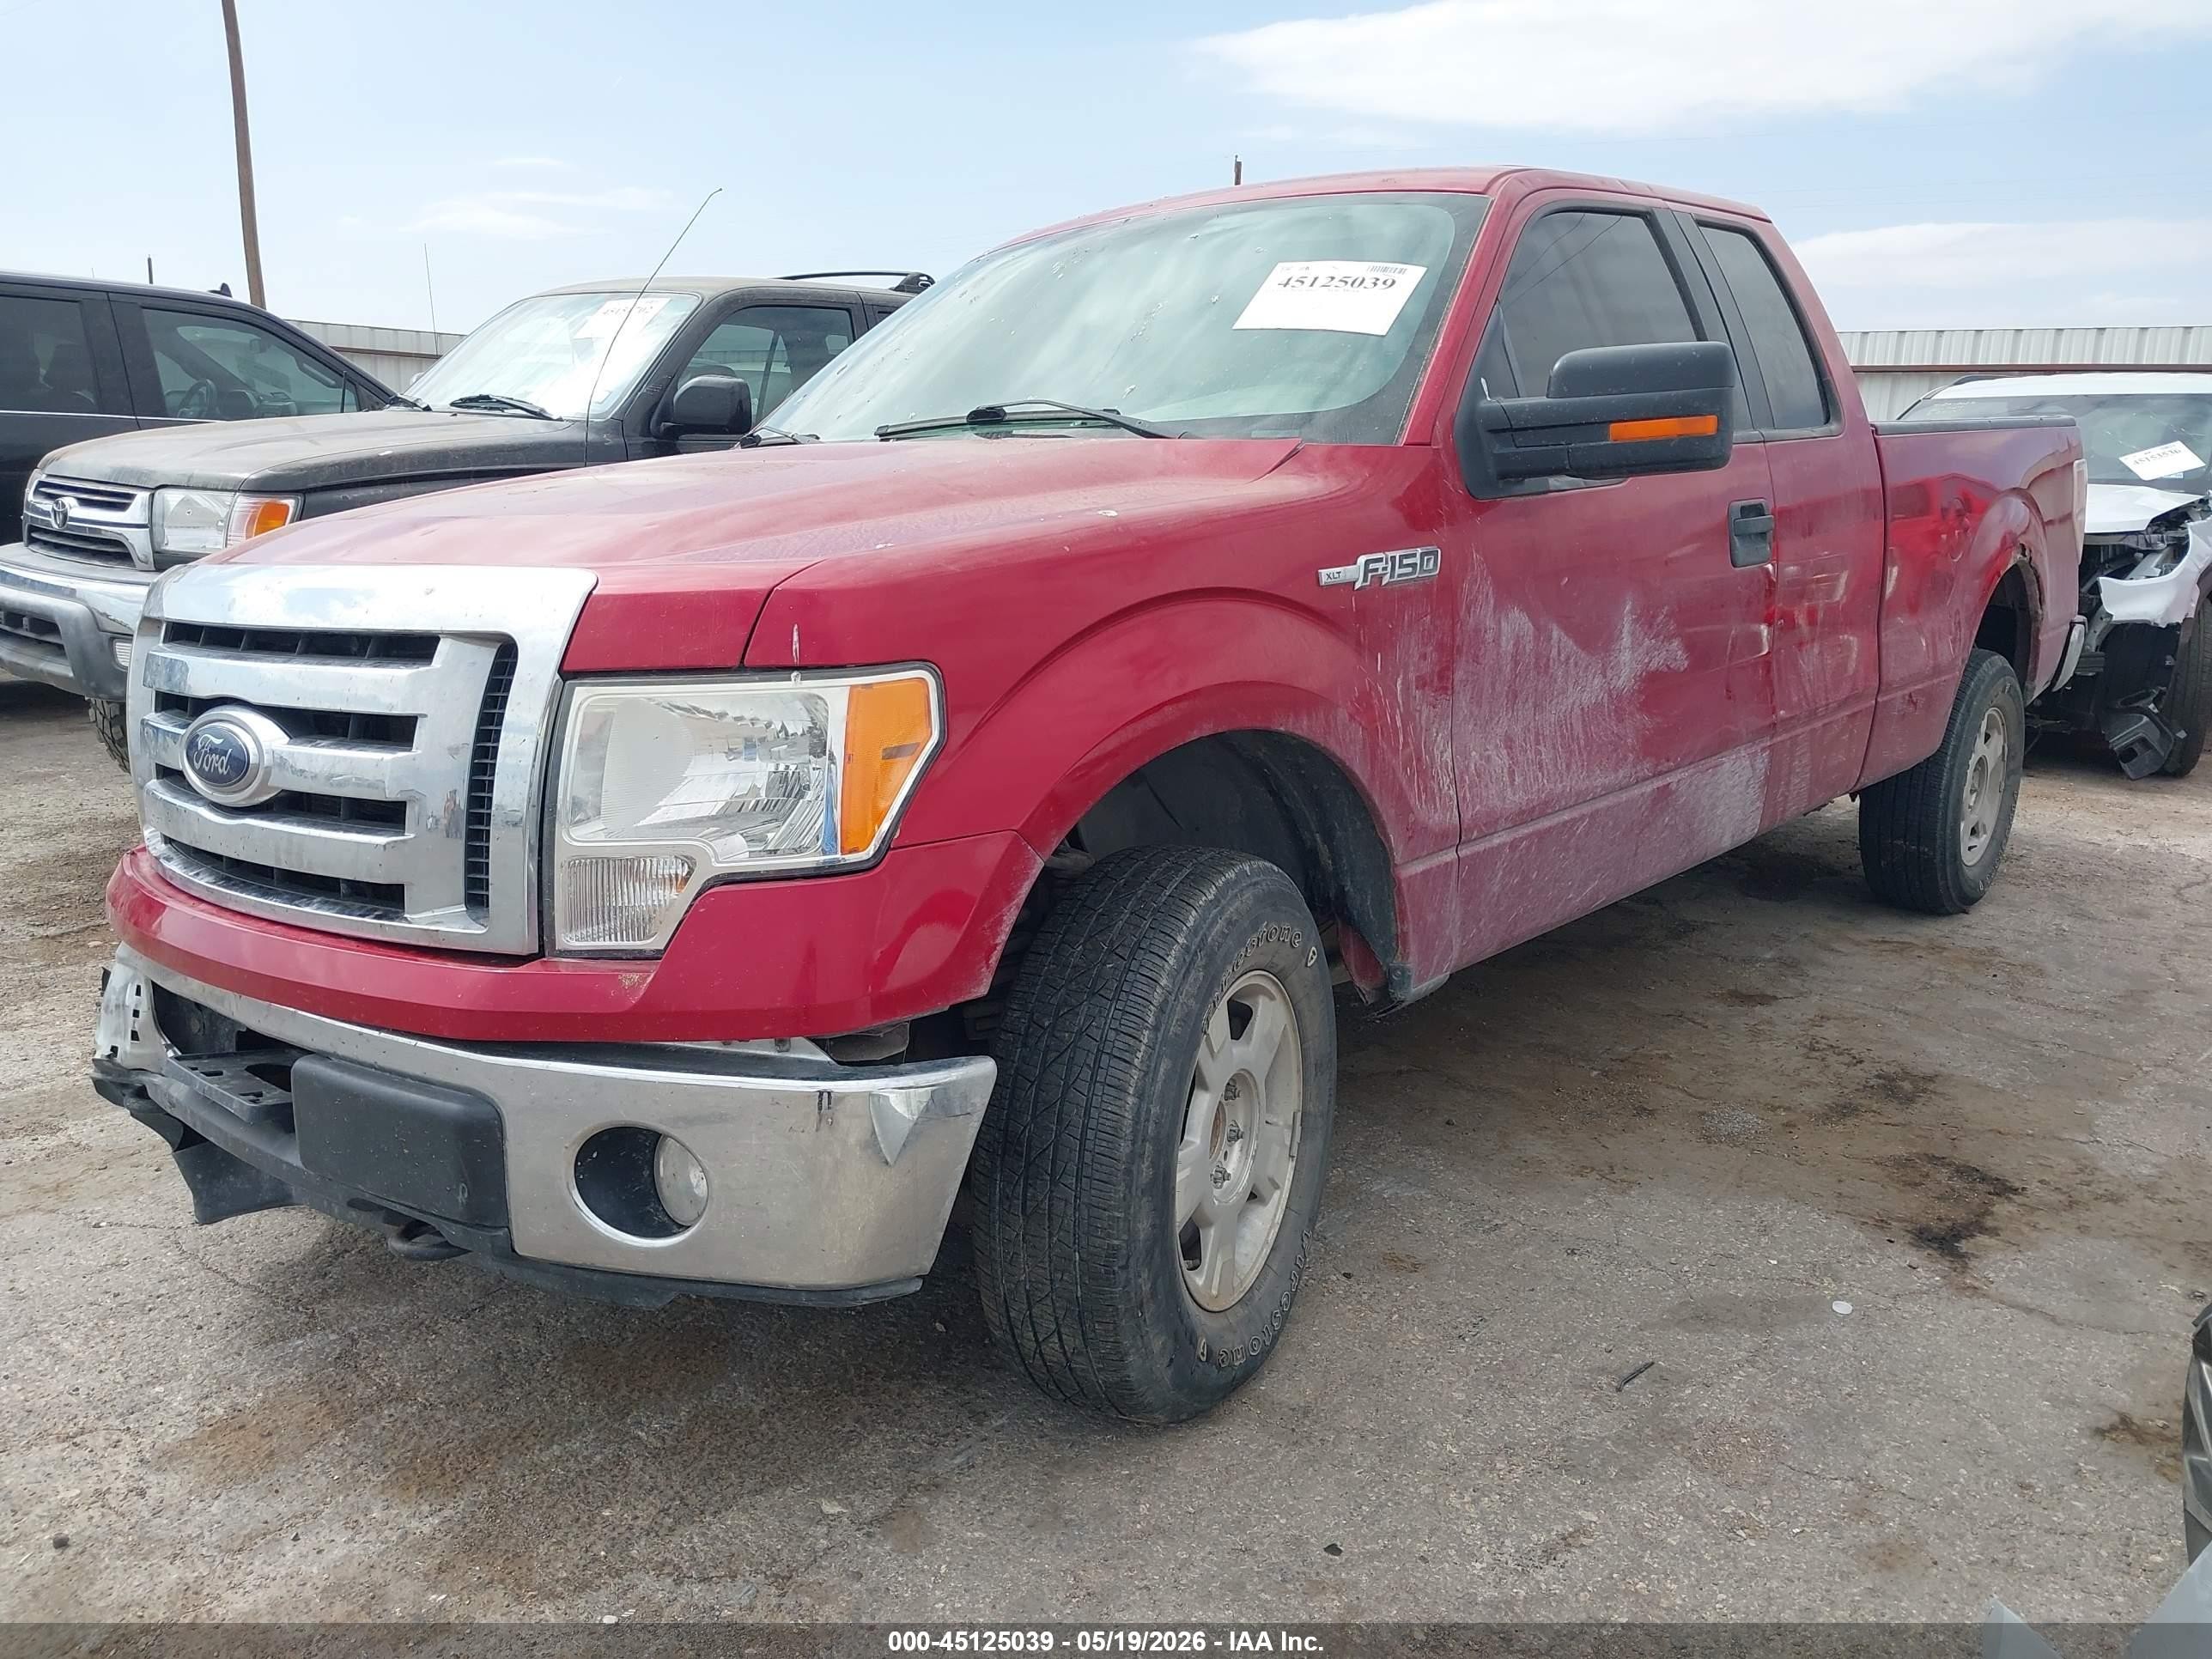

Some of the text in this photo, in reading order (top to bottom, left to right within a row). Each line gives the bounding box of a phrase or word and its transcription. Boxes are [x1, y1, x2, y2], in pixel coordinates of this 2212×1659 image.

[1277, 275, 1397, 290] 45125039
[1325, 546, 1442, 591] XLT F-150
[193, 733, 234, 775] Ford
